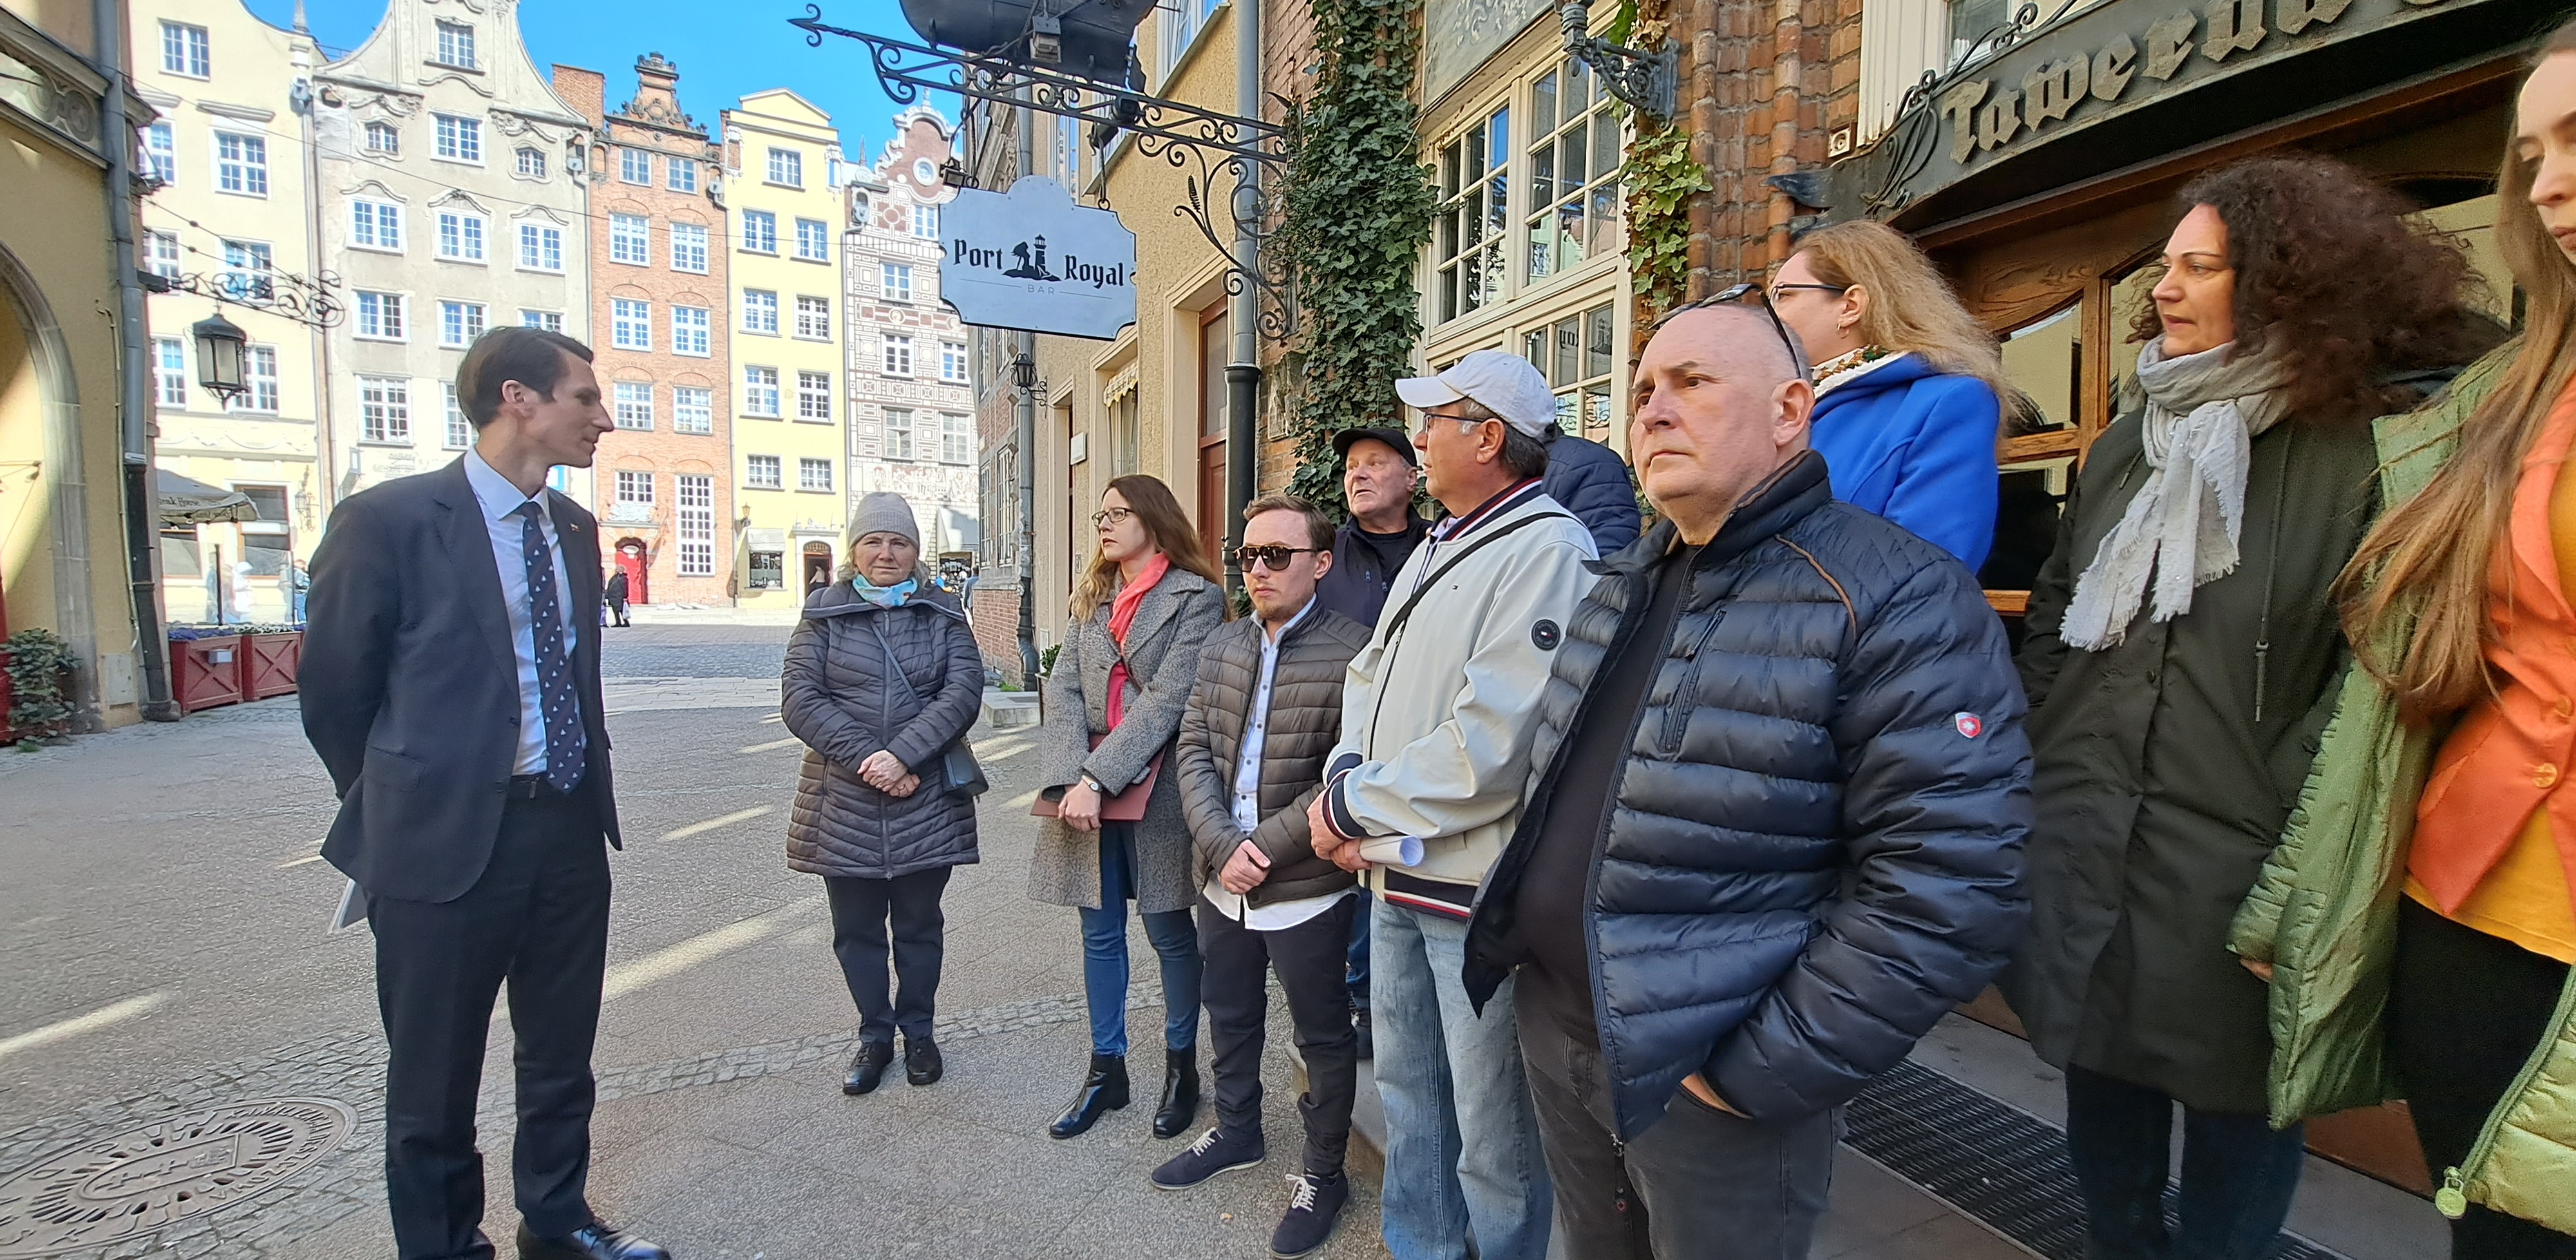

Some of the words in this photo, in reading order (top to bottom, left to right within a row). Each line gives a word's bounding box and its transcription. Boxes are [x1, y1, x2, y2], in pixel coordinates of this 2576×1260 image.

[954, 238, 1003, 270] Port
[1065, 254, 1124, 290] Royal
[1027, 284, 1056, 296] BAR
